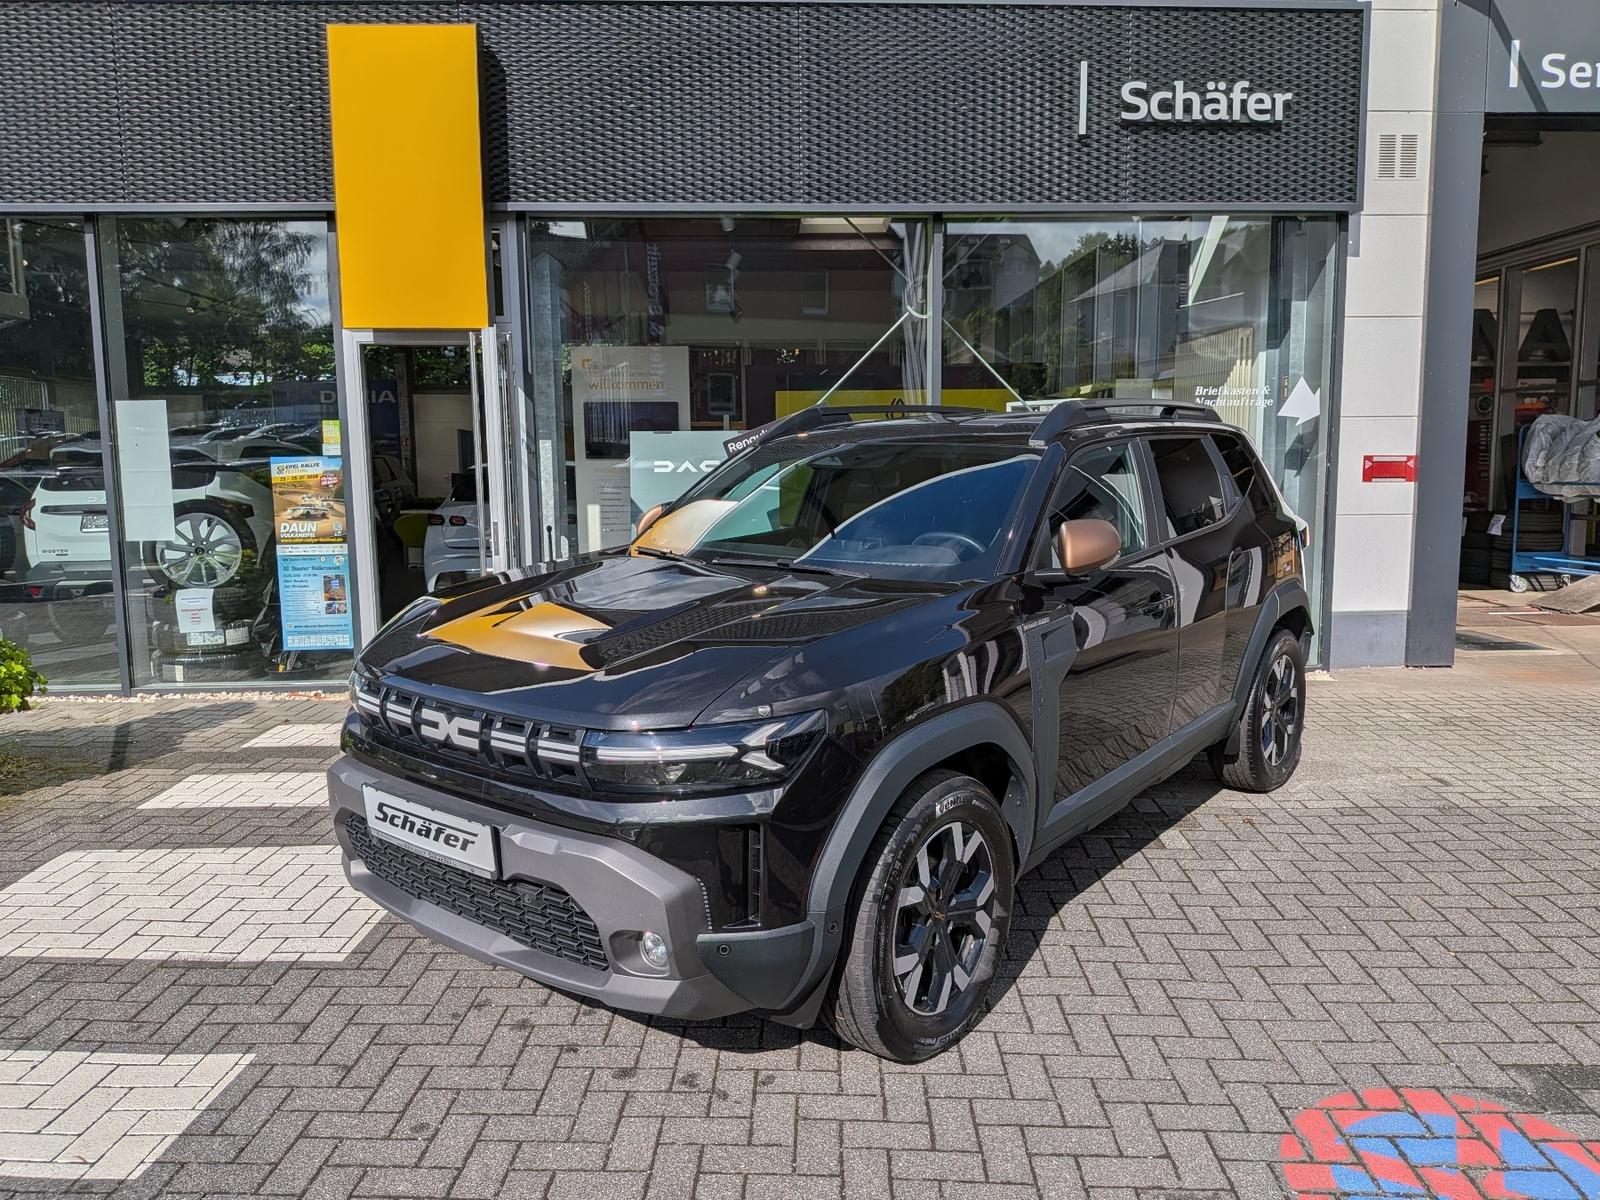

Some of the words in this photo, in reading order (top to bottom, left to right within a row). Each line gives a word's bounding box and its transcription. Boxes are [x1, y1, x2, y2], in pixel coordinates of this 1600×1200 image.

[1540, 53, 1600, 89] Se
[1120, 80, 1293, 121] Schäfer
[1194, 385, 1259, 396] Briefkasten
[1263, 385, 1271, 395] &
[280, 522, 317, 533] DAUN
[374, 801, 479, 852] Schäfer
